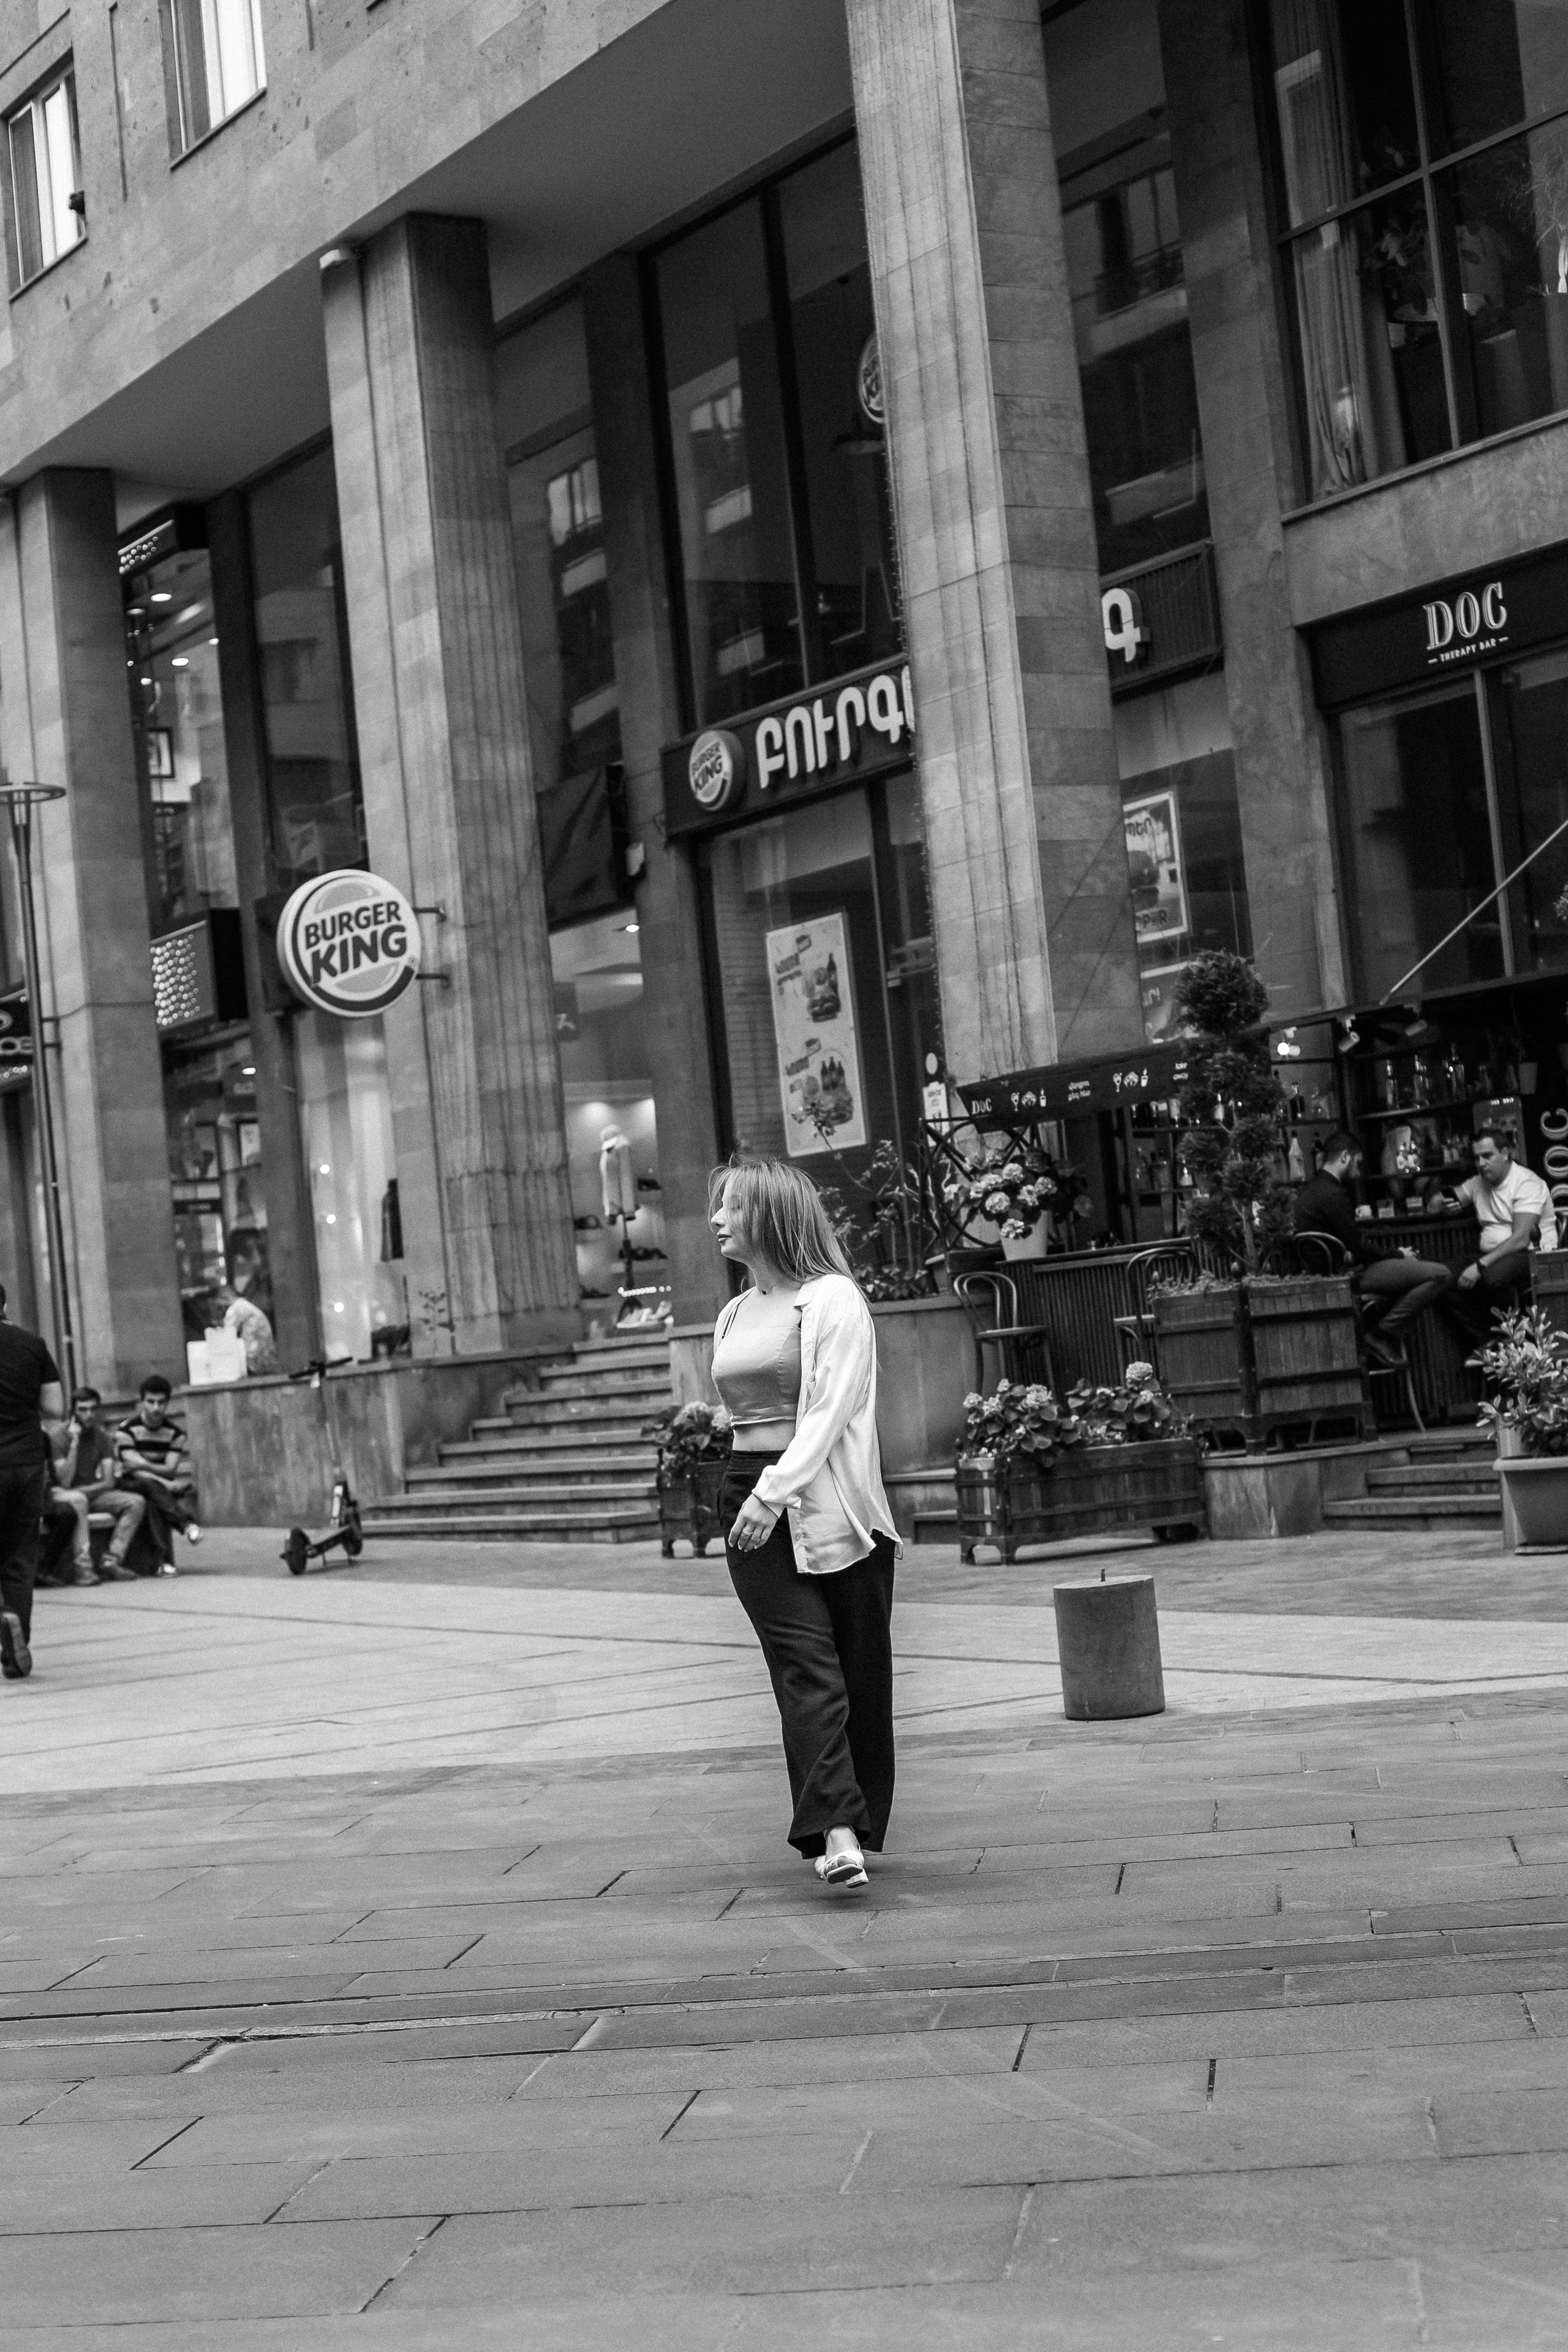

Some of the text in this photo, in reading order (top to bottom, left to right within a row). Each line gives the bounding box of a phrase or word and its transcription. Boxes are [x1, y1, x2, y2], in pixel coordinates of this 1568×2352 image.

[1422, 582, 1507, 650] DOC
[1439, 638, 1496, 662] THERAPY BAR
[692, 741, 721, 777] BURGER
[694, 754, 722, 791] KING
[305, 901, 401, 949] BURGER
[312, 924, 407, 984] KING
[971, 1098, 992, 1114] DOC
